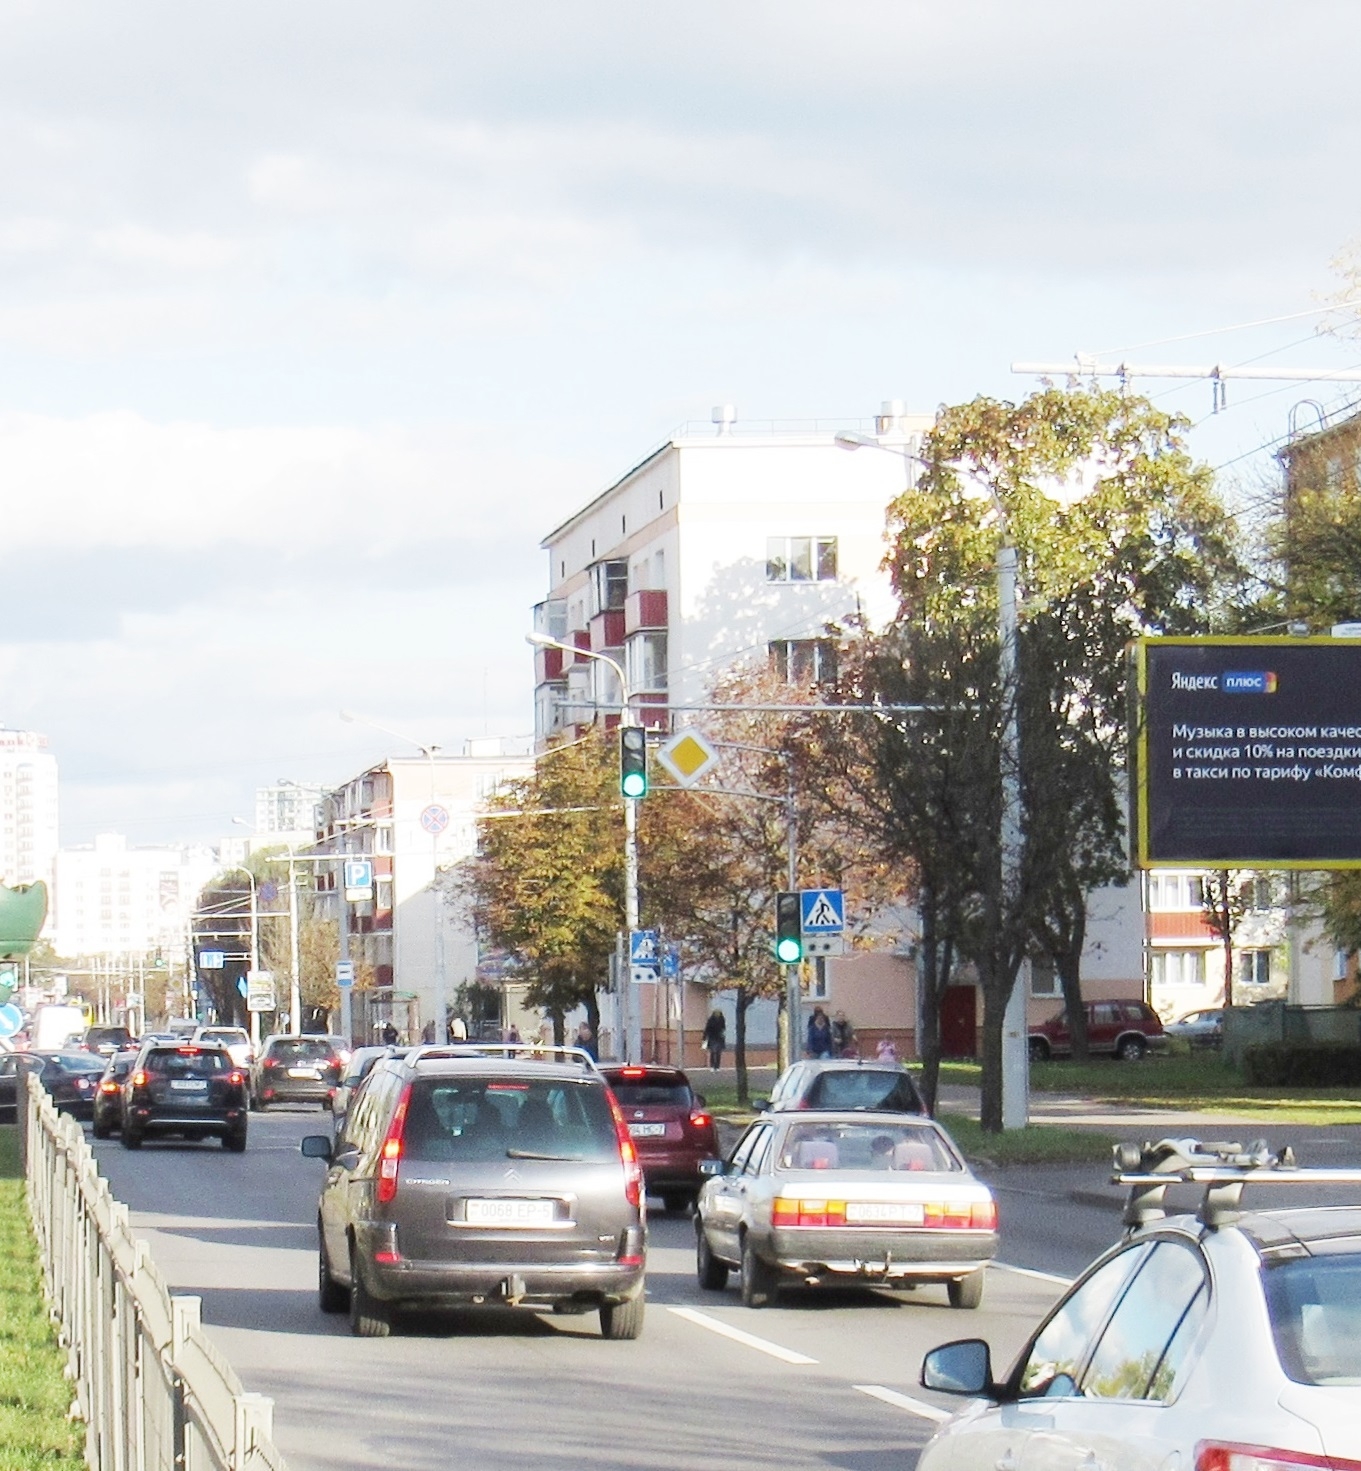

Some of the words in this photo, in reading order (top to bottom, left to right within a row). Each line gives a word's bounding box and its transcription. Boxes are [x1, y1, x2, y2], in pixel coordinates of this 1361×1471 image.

[1171, 671, 1218, 691] Яндекс
[1226, 677, 1262, 688] плюс
[1172, 724, 1233, 741] Музыка
[1236, 727, 1246, 738] в
[1249, 727, 1317, 738] высоком
[1172, 747, 1183, 759] и
[1186, 747, 1240, 760] скидка
[1244, 744, 1273, 758] 10%
[1276, 747, 1295, 758] на
[1298, 747, 1361, 761] поездки
[1173, 767, 1182, 779] в
[1185, 767, 1228, 779] такси
[1232, 767, 1251, 779] по
[1254, 764, 1311, 781] тарифу
